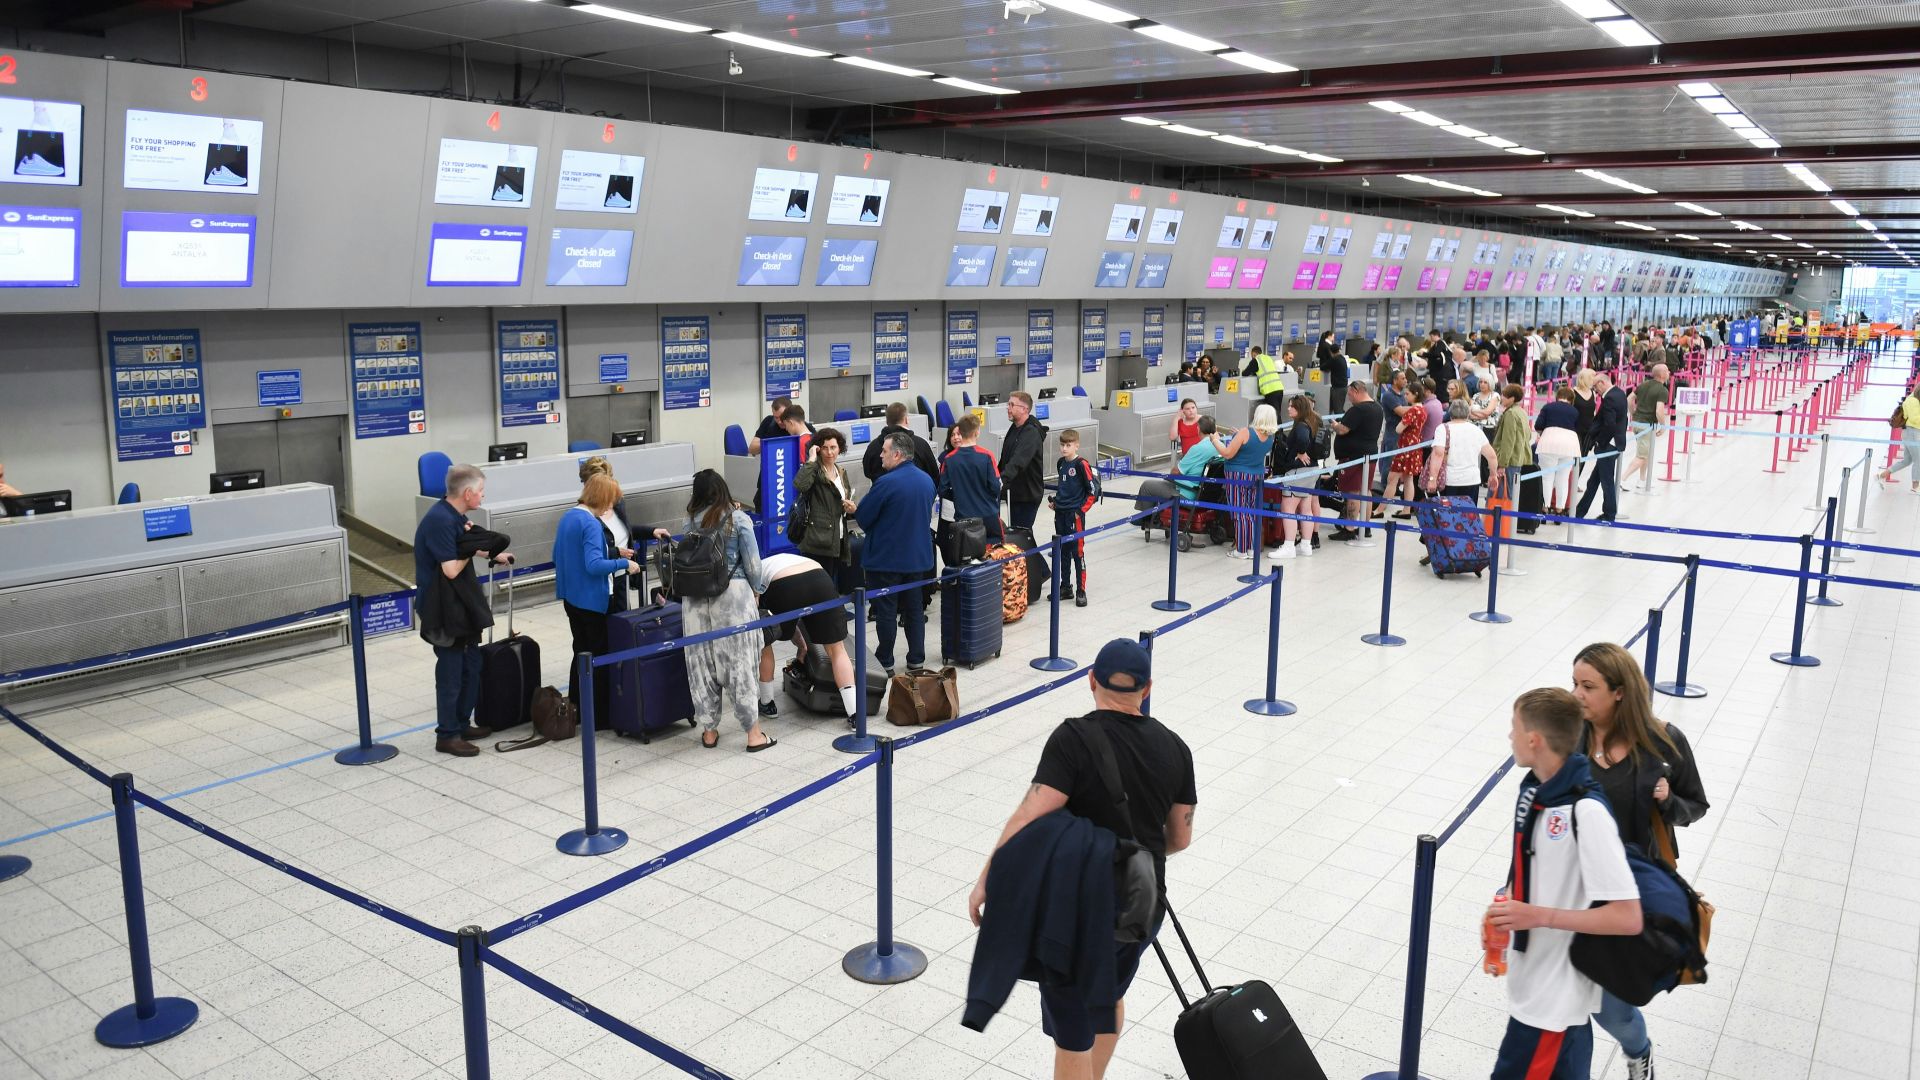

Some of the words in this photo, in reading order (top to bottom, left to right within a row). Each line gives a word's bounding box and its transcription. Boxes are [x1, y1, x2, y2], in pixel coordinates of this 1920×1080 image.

[0, 55, 17, 84] 2
[190, 77, 208, 101] 3
[487, 111, 501, 131] 4
[602, 123, 616, 143] 5
[164, 140, 196, 148] SHOPPING
[27, 214, 74, 222] SunExpress
[209, 220, 249, 228] SunExpress
[598, 248, 616, 256] Desk
[779, 252, 792, 260] Desk
[853, 254, 864, 262] Desk
[578, 258, 602, 268] Closed
[762, 262, 781, 270] Closed
[371, 600, 396, 610] NOTICE
[1516, 787, 1537, 828] Jom
